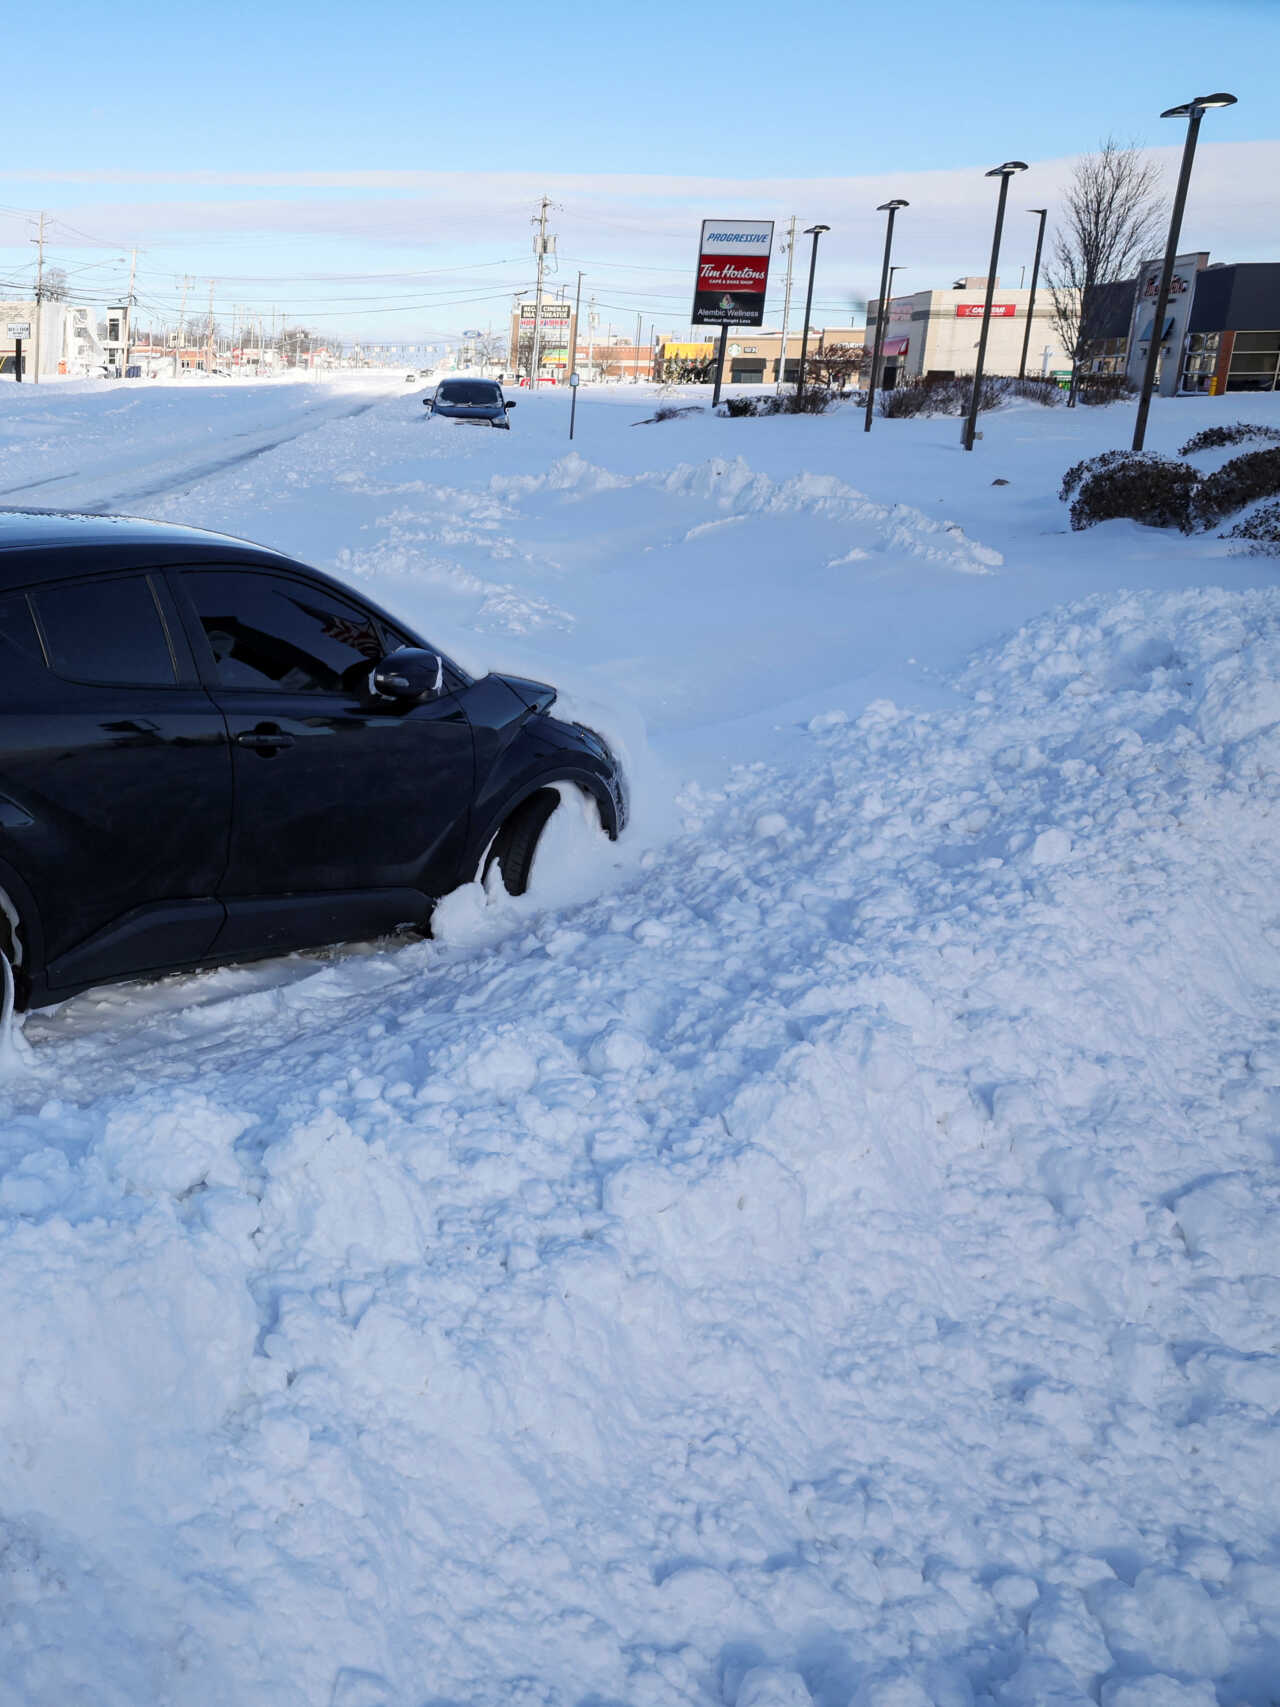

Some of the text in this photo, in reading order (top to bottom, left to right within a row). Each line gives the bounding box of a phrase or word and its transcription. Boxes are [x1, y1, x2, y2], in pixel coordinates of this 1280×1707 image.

[707, 233, 769, 243] PROGRESSIVE
[700, 264, 765, 280] Tim Hortons
[727, 308, 759, 317] Wellness
